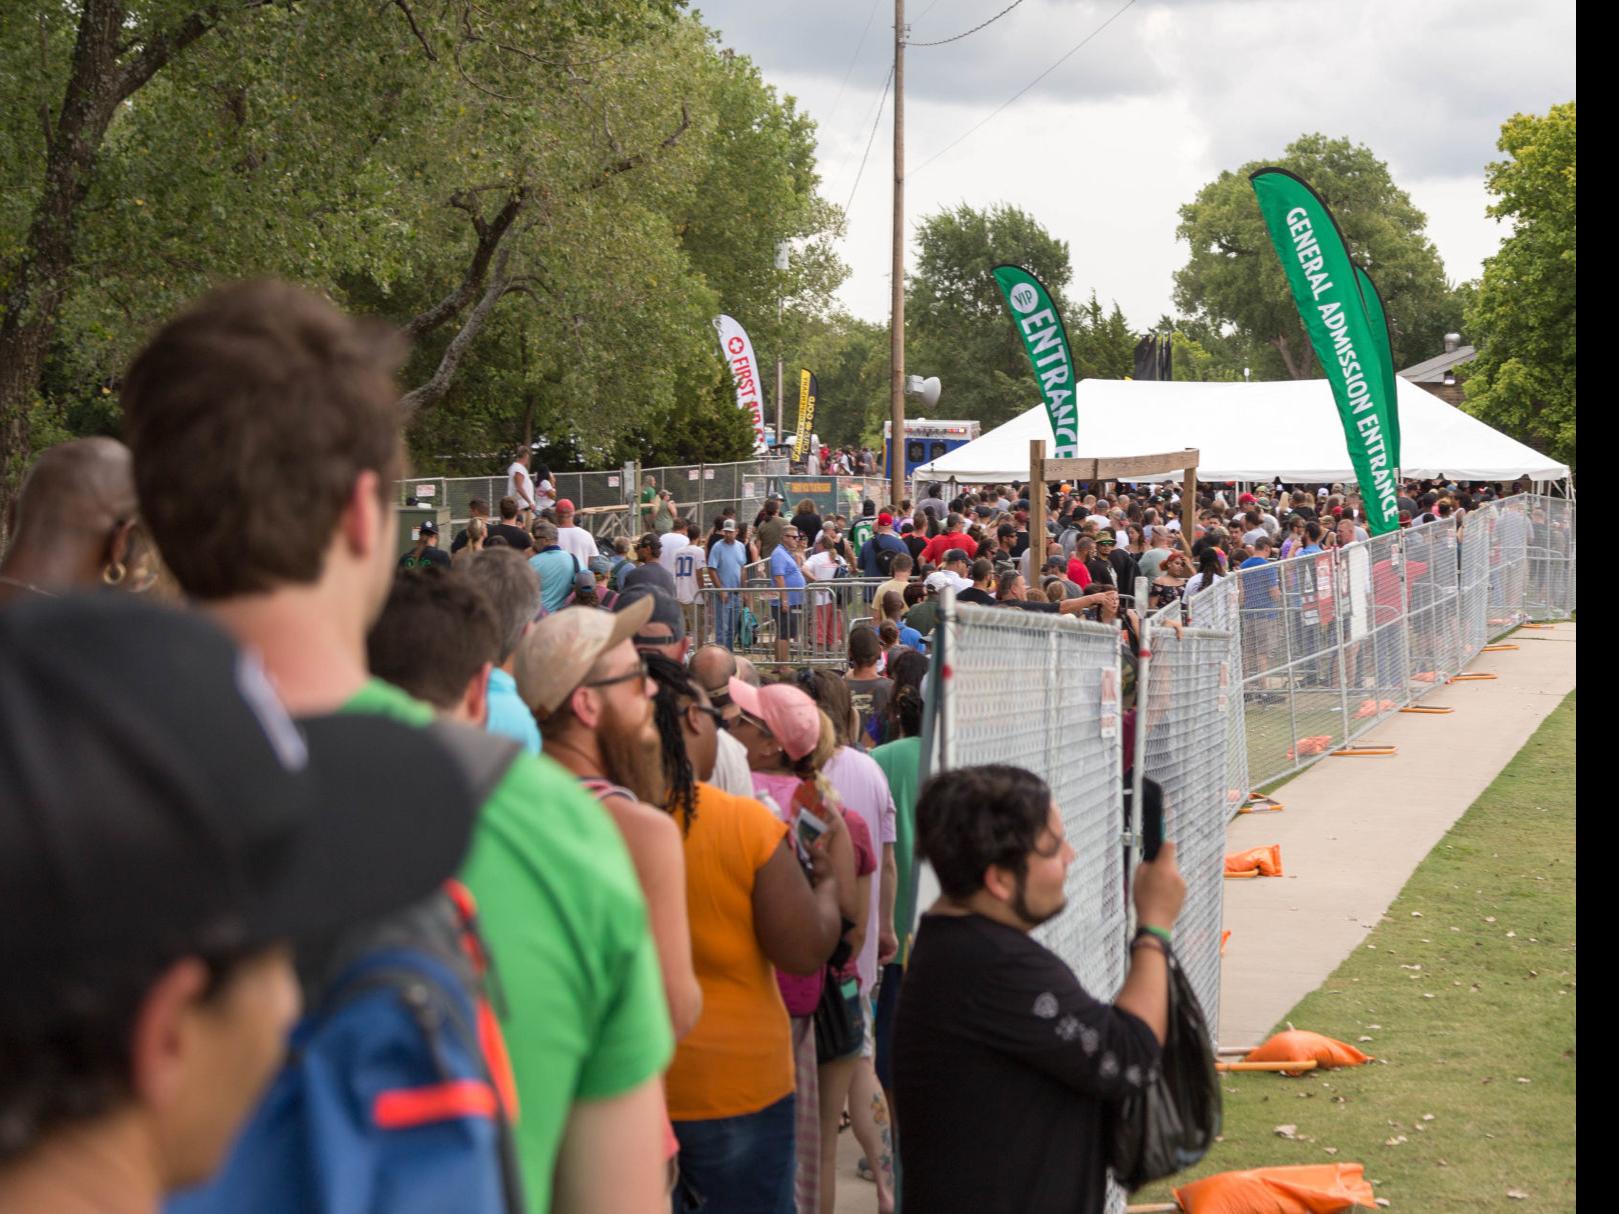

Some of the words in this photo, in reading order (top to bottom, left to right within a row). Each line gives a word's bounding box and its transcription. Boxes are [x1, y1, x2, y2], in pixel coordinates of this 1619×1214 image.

[1014, 289, 1033, 307] VIP
[733, 357, 756, 397] FIRST
[1021, 308, 1077, 458] ENTRANCE
[1286, 207, 1333, 300] GENERAL
[1317, 302, 1373, 414] ADMISSION
[1356, 413, 1399, 523] ENTRANCE
